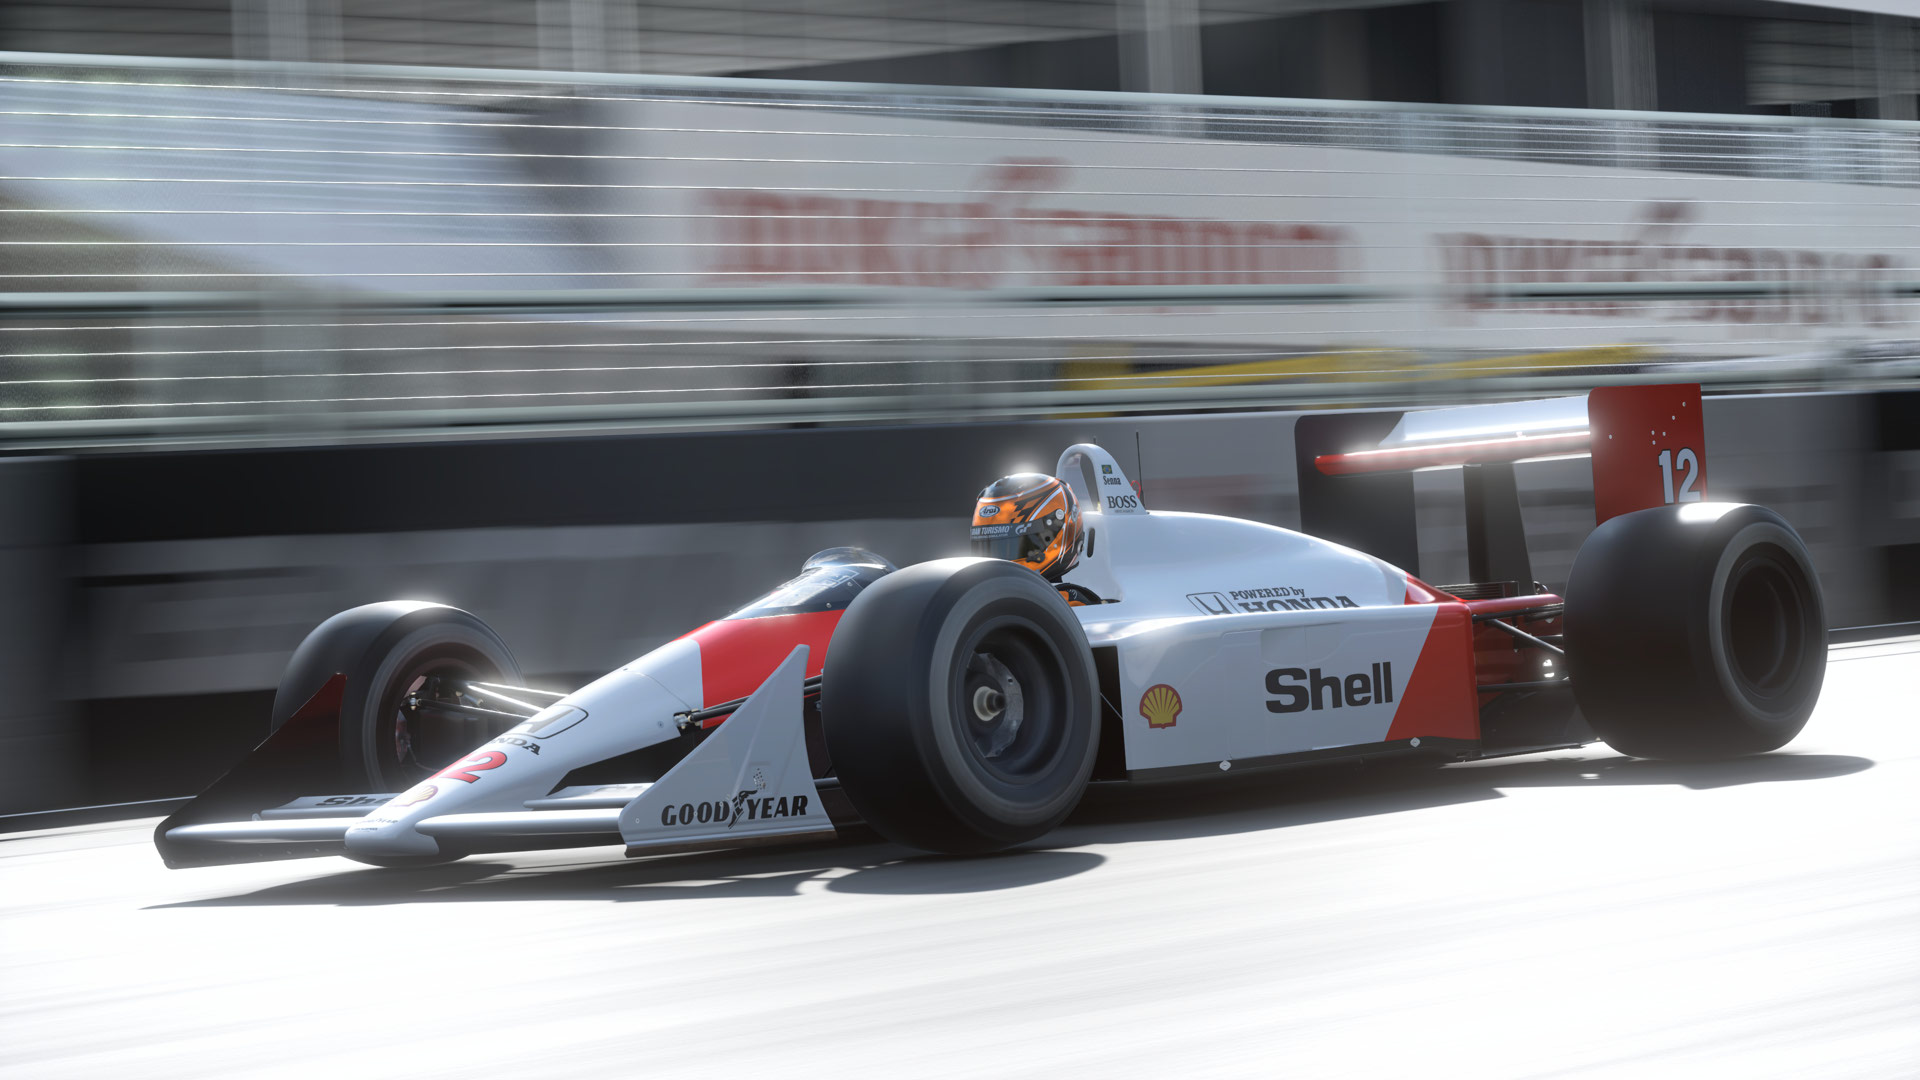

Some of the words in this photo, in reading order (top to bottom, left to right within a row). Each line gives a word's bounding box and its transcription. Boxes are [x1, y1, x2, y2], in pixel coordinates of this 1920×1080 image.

[1102, 475, 1121, 485] Senna
[1658, 447, 1701, 504] 12
[1106, 495, 1137, 509] BOSS
[1229, 587, 1290, 600] POWERED
[1290, 586, 1305, 597] by
[1264, 661, 1394, 714] Shell
[488, 737, 541, 755] NDA
